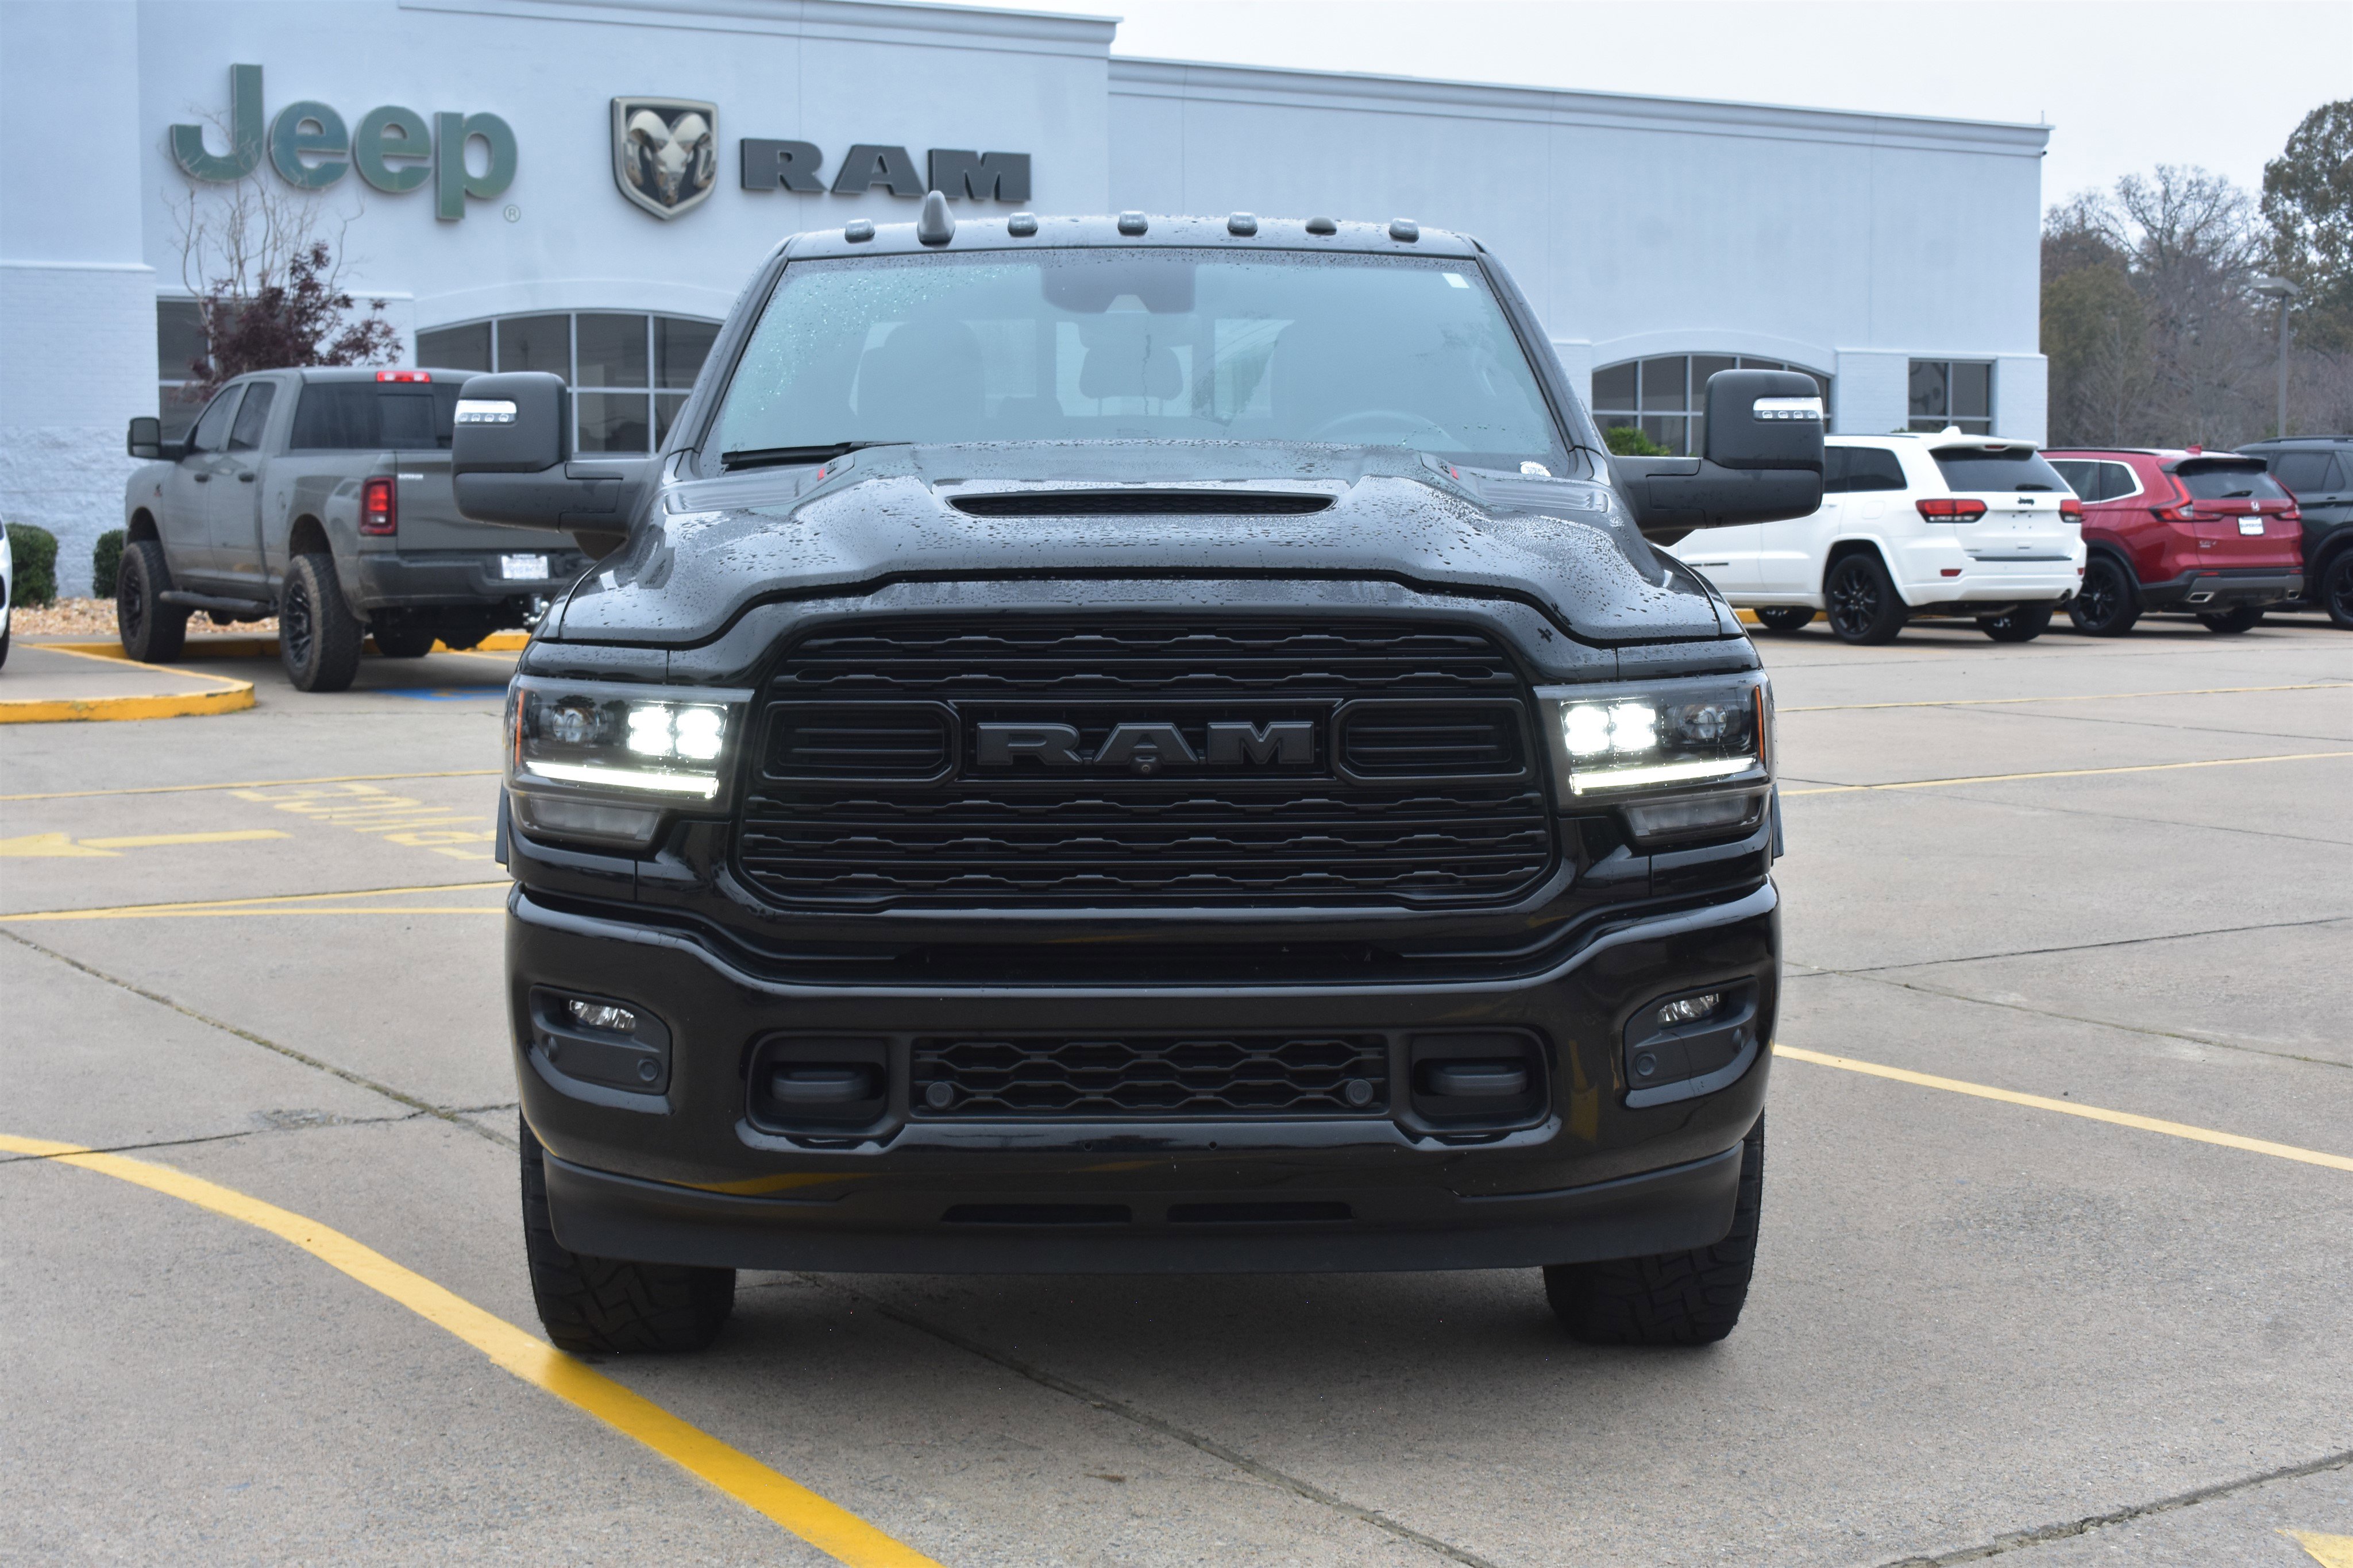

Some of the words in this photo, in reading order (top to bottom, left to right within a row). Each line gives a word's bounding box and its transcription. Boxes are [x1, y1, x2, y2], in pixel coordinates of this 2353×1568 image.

[169, 63, 518, 221] Jeep
[740, 138, 1032, 202] RAM
[977, 722, 1314, 766] RAM
